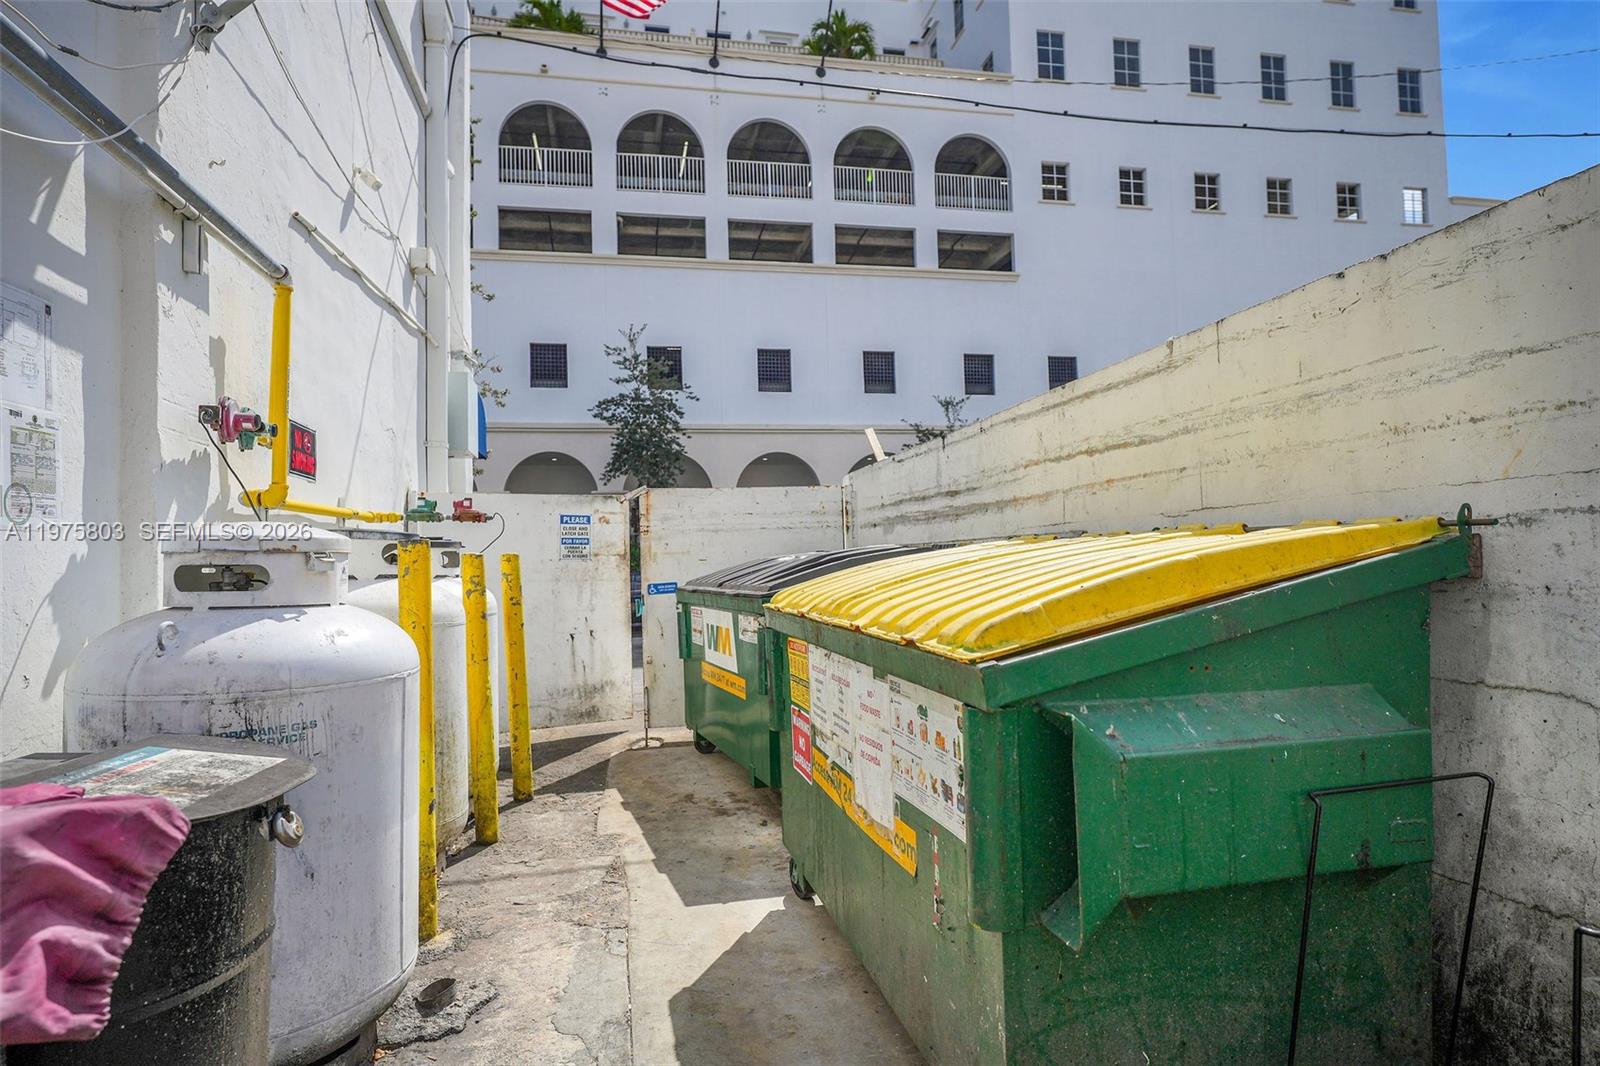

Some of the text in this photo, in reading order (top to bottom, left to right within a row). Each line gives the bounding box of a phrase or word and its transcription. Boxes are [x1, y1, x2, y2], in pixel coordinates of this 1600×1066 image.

[563, 516, 589, 524] PLEASE
[706, 623, 733, 657] WM
[291, 719, 318, 732] GAS
